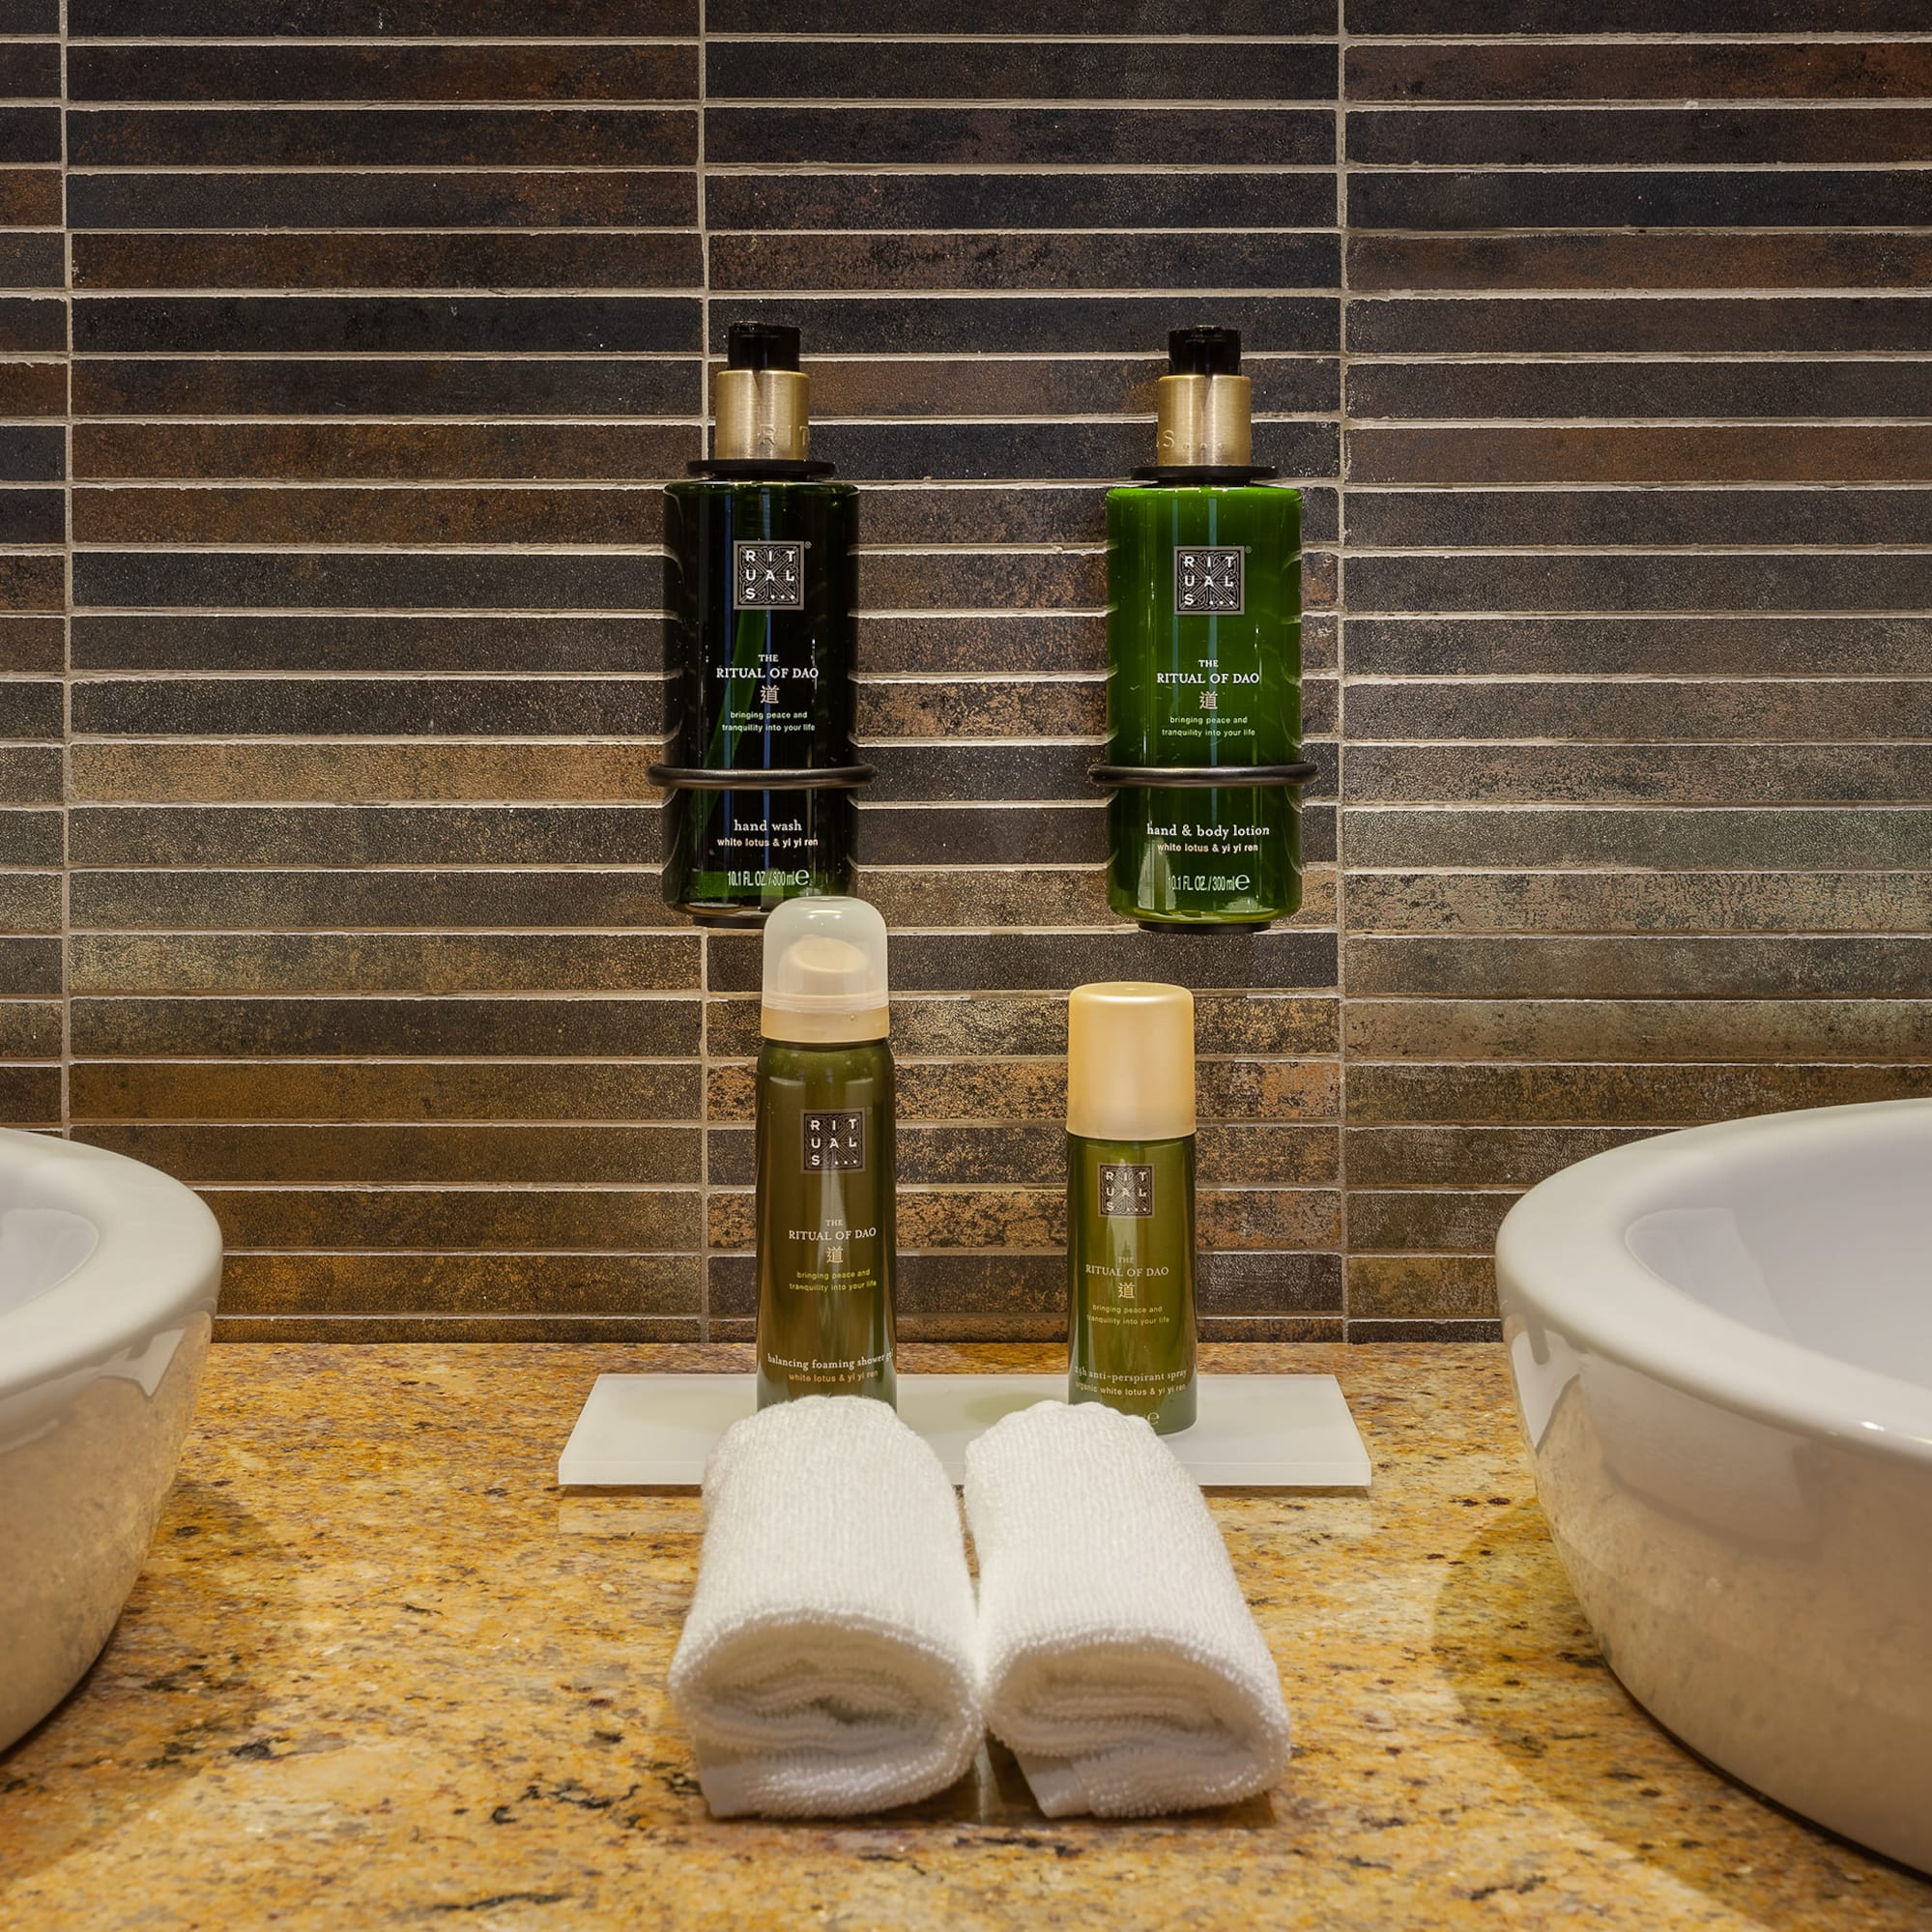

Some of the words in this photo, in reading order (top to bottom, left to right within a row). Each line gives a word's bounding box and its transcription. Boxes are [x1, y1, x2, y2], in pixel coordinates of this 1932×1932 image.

[745, 550, 794, 562] RIT
[1184, 556, 1234, 567] RIT
[745, 569, 794, 581] UAL
[1184, 575, 1234, 587] UAL
[1198, 659, 1219, 668] THE
[716, 668, 765, 678] RITUAL
[769, 668, 789, 678] OF
[792, 668, 820, 678] DAO
[1156, 673, 1206, 684] RITUAL
[1209, 673, 1229, 684] OF
[1232, 673, 1260, 684] DAO
[760, 684, 780, 704] 道
[1199, 691, 1218, 709] 道
[730, 711, 764, 720] bringing
[1169, 716, 1203, 725] bringing
[722, 724, 763, 733] tranquility
[1162, 729, 1202, 737] tranquility
[734, 820, 767, 831] hand
[771, 820, 802, 831] wash
[1146, 822, 1177, 836] hand
[1181, 823, 1193, 837] &
[1197, 824, 1229, 841] body
[1232, 824, 1270, 837] lotion
[717, 838, 742, 847] white
[745, 838, 769, 847] lotus
[772, 838, 780, 847] &
[782, 838, 791, 849] yi
[793, 838, 802, 849] yi
[804, 838, 818, 847] ren
[1157, 843, 1182, 852] white
[1184, 844, 1209, 852] lotus
[1212, 844, 1220, 852] &
[1222, 844, 1230, 854] yi
[1233, 844, 1242, 854] yi
[811, 1119, 857, 1131] RIT
[811, 1137, 857, 1149] UAL
[1106, 1171, 1147, 1181] RIT
[1106, 1188, 1147, 1197] UAL
[789, 1229, 832, 1241] RITUAL
[835, 1230, 851, 1241] OF
[854, 1226, 877, 1239] DAO
[826, 1245, 844, 1263] 道
[796, 1271, 829, 1281] bringing
[832, 1272, 855, 1281] peace
[857, 1268, 871, 1277] and
[1085, 1264, 1124, 1277] RITUAL
[1126, 1268, 1142, 1278] OF
[1146, 1266, 1169, 1277] DAO
[789, 1283, 828, 1293] tranquility
[849, 1283, 865, 1291] your
[1117, 1282, 1136, 1299] 道
[1092, 1304, 1121, 1314] bringing
[1149, 1305, 1163, 1313] and
[1086, 1314, 1121, 1326] tranquility
[767, 1352, 809, 1370] balancing
[811, 1359, 855, 1370] foaming
[857, 1355, 885, 1367] shower
[788, 1373, 811, 1382] white
[814, 1373, 835, 1383] lotus
[839, 1373, 846, 1382] &
[848, 1372, 855, 1383] yi
[857, 1371, 865, 1382] yi
[1088, 1370, 1165, 1384] anti-perspirant
[1167, 1370, 1187, 1382] spray
[1100, 1386, 1122, 1396] white
[1125, 1387, 1147, 1396] lotus
[1158, 1387, 1166, 1396] yi
